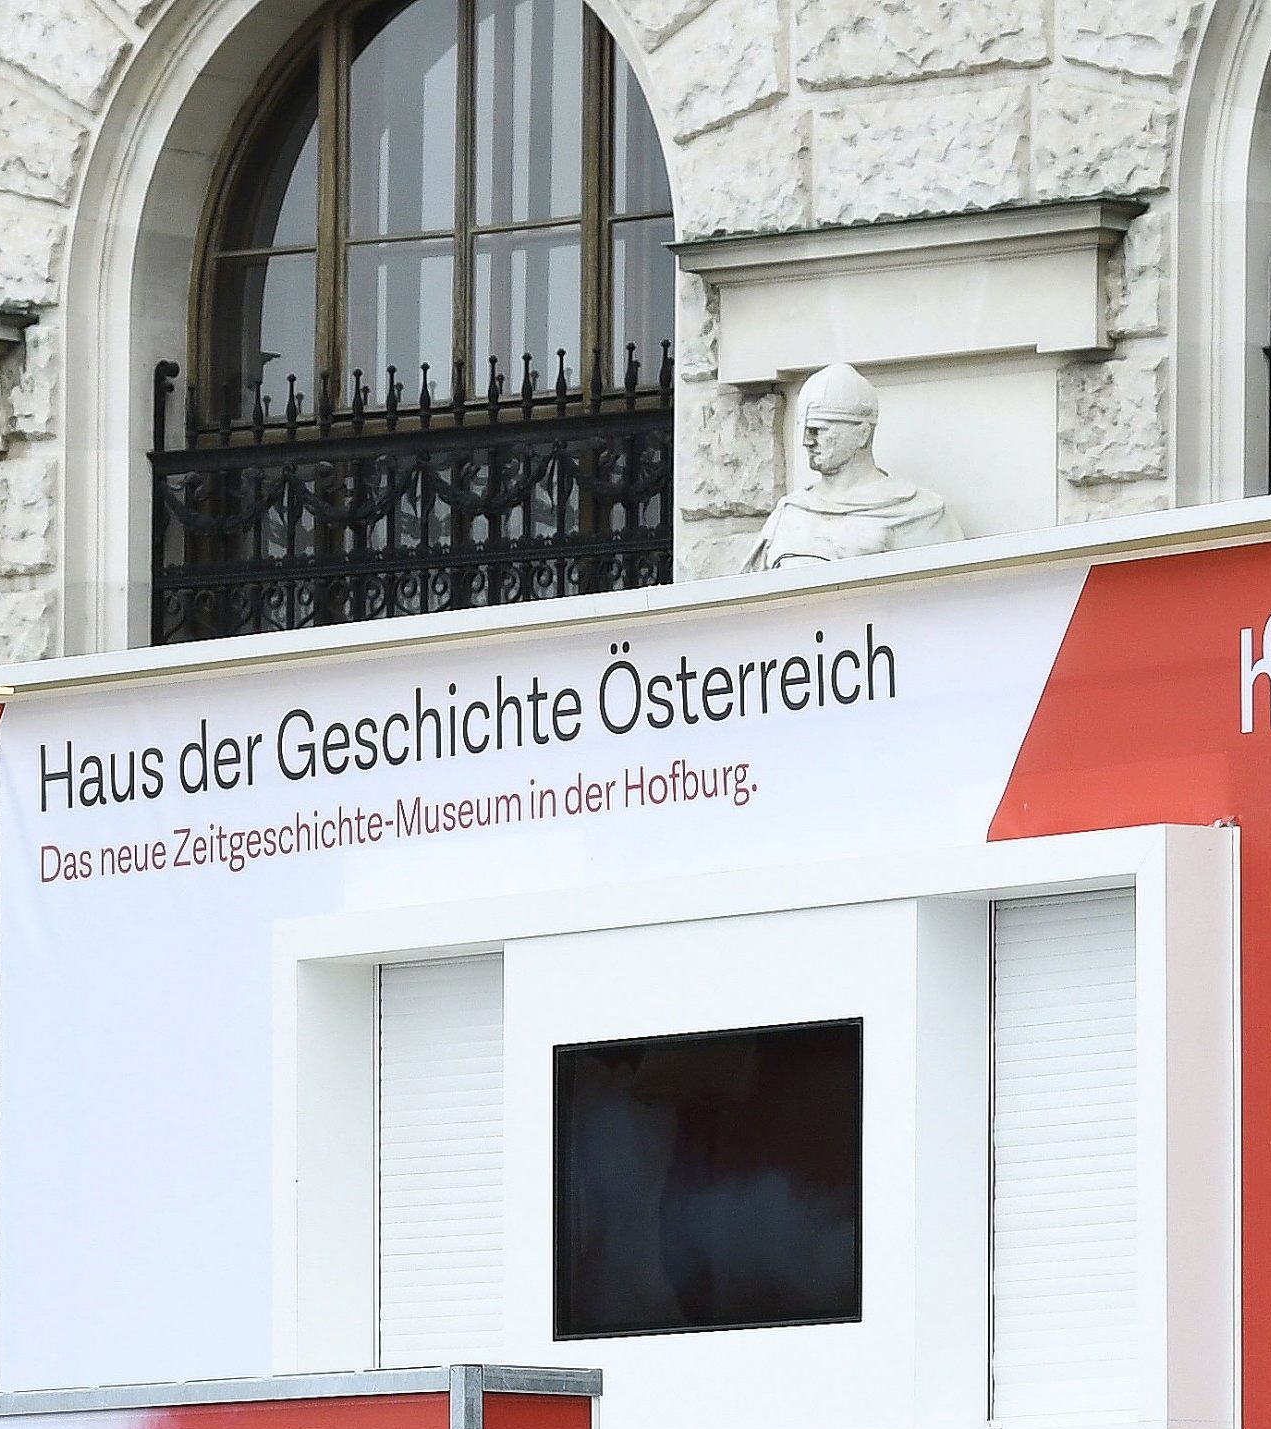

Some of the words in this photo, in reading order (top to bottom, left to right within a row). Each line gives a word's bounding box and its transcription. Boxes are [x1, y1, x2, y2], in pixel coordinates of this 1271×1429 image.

[40, 740, 164, 813] Haus
[179, 718, 263, 794] der
[276, 675, 582, 781] Geschichte
[599, 623, 896, 735] Österreich
[41, 845, 93, 883] Das
[101, 841, 167, 876] neue
[173, 780, 521, 873] Zeitgeschichte-Museum
[529, 781, 557, 820] in
[565, 772, 617, 815] der
[625, 759, 758, 808] Hofburg.
